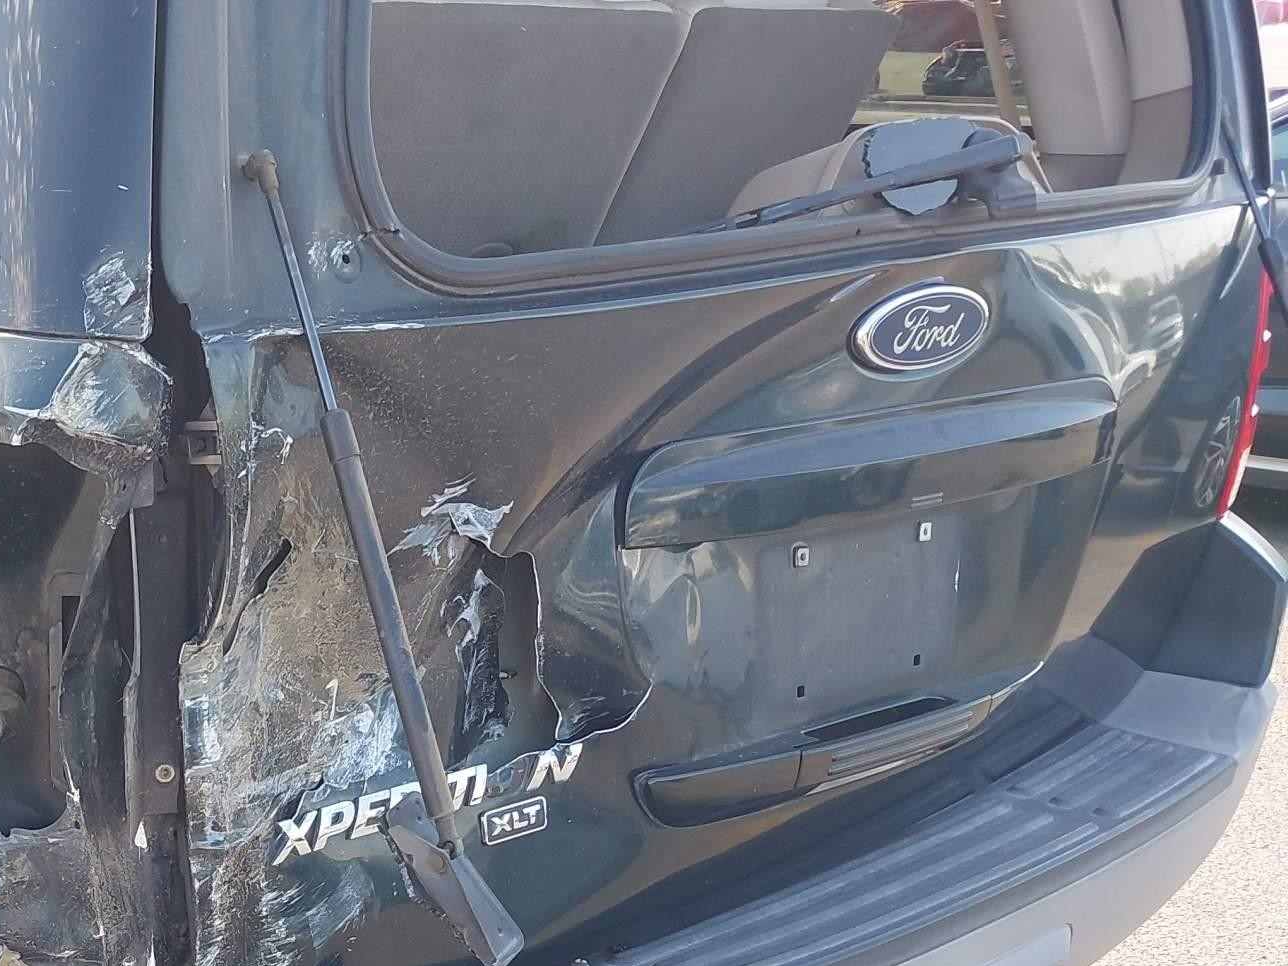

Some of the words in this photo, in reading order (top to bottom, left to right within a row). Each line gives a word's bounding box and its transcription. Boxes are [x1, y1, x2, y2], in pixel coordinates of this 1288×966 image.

[893, 304, 965, 355] Ford
[272, 743, 583, 866] XPETIN
[490, 804, 542, 837] XLT
